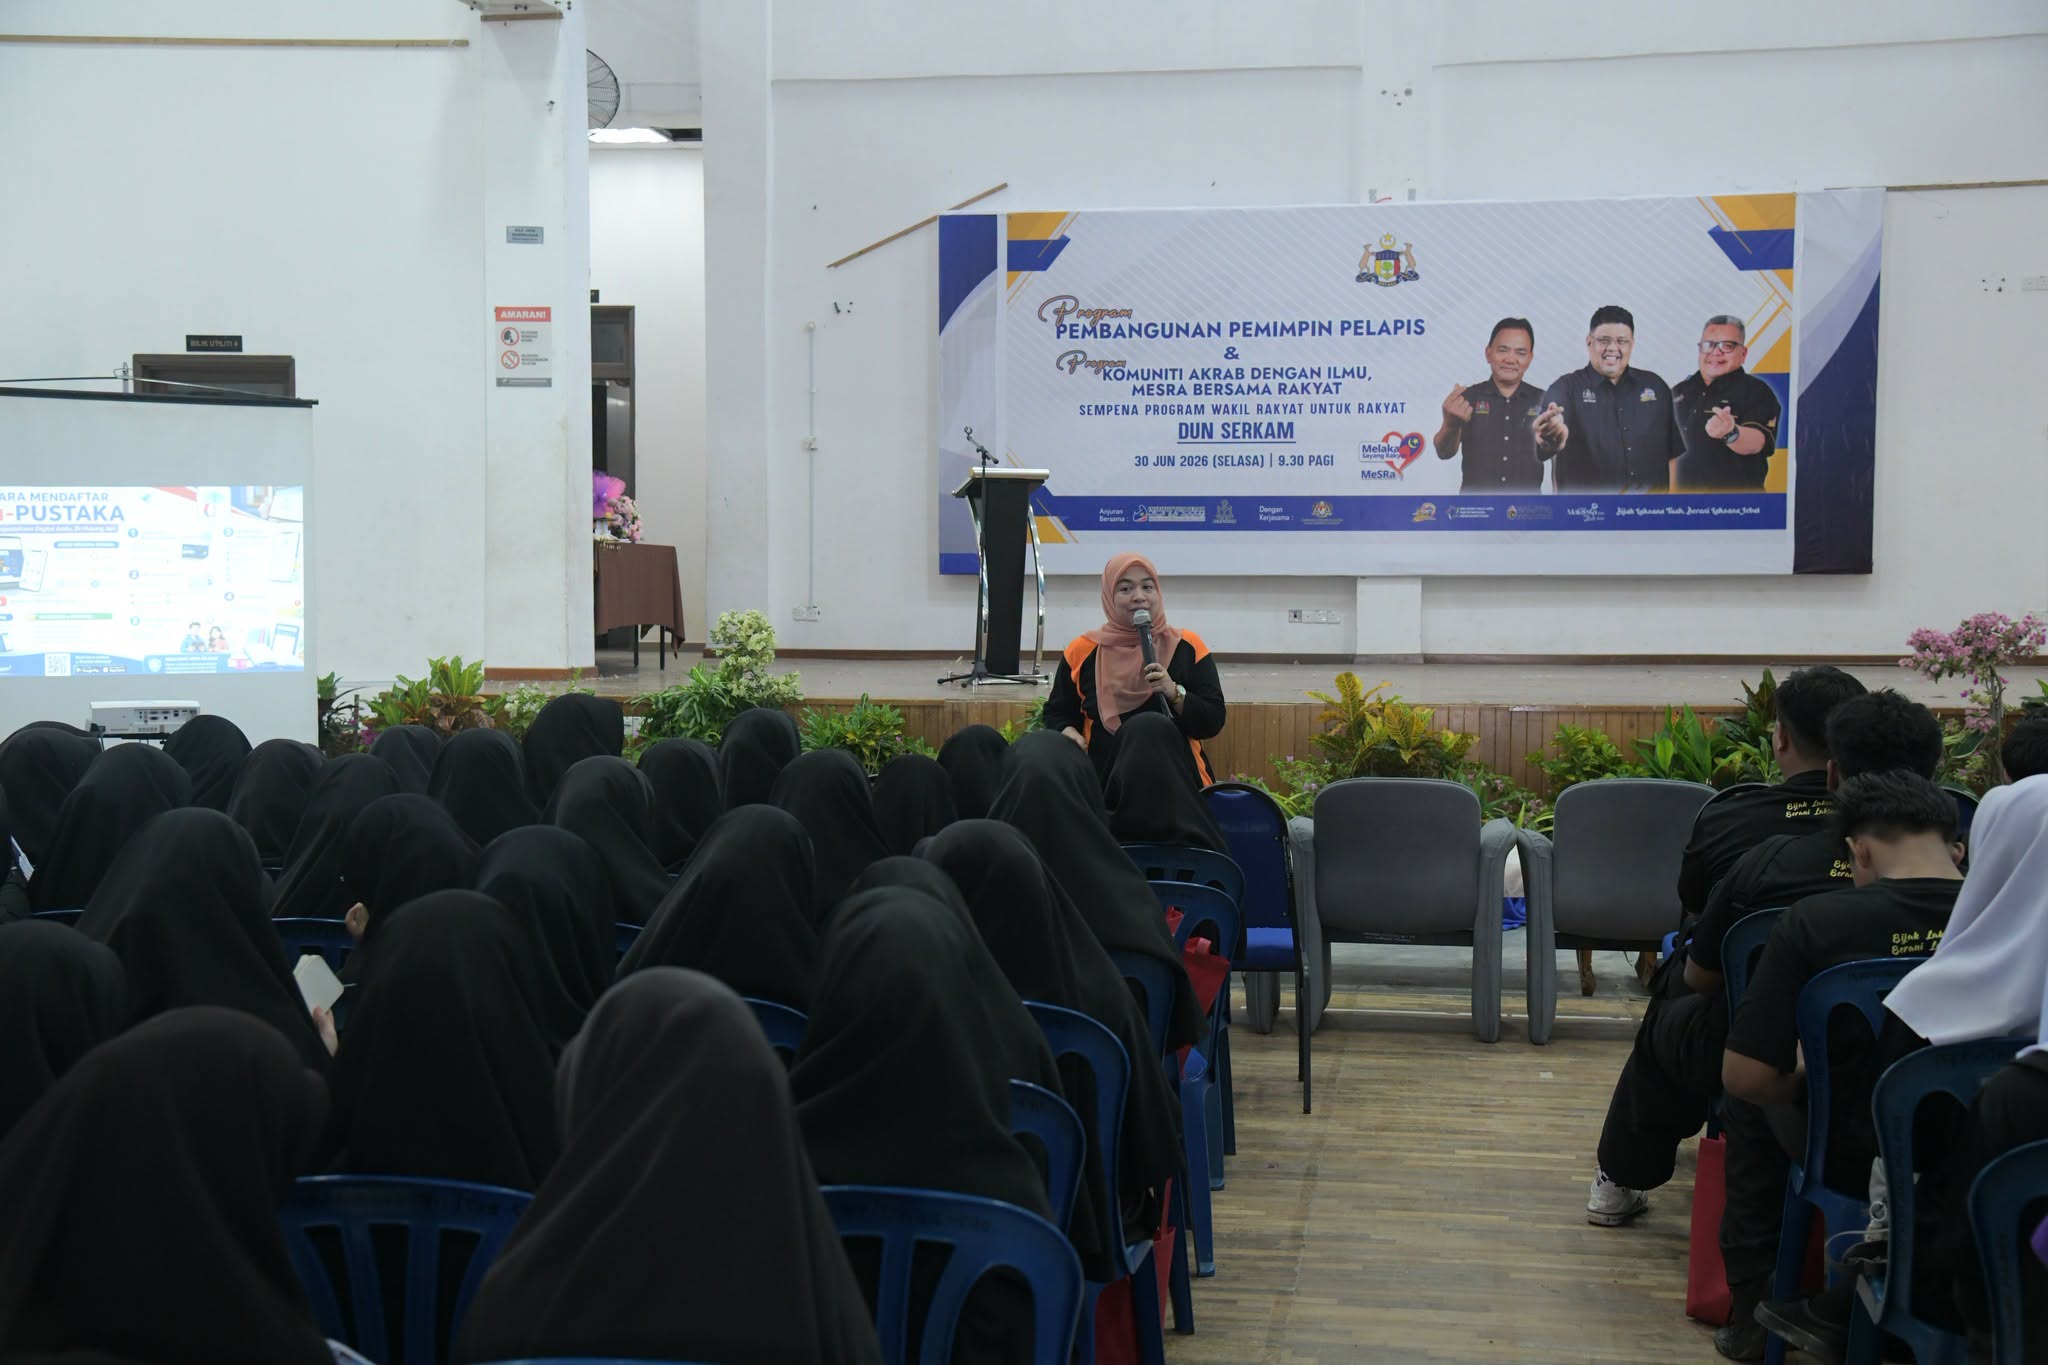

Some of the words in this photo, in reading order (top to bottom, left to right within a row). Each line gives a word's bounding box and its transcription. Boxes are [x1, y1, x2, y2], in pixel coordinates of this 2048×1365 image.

[1038, 294, 1133, 328] Program
[1055, 321, 1222, 340] PEMBANGUNAN
[1229, 320, 1333, 338] PEMIMPIN
[1340, 318, 1426, 336] PELAPIS
[1223, 346, 1240, 360] &
[1055, 349, 1127, 375] Program
[1102, 367, 1183, 382] KOMUNITI
[1188, 367, 1245, 381] AKRAB
[1250, 366, 1322, 380] DENGAN
[1327, 365, 1373, 383] ILMU,
[1131, 383, 1188, 397] MESRA
[1193, 382, 1273, 396] BERSAMA
[1277, 381, 1343, 396] RAKYAT
[1079, 404, 1139, 416] SEMPENA
[1144, 403, 1205, 416] PROGRAM
[1211, 403, 1251, 416] WAKIL
[1256, 402, 1304, 415] RAKYAT
[1310, 402, 1351, 415] UNTUK
[1357, 402, 1406, 414] RAKYAT
[1178, 421, 1214, 440] DUN
[1220, 421, 1294, 440] SERKAM
[1362, 444, 1400, 453] Melaka
[1134, 455, 1149, 467] 30
[1152, 455, 1176, 467] JUN
[1179, 455, 1209, 467] 2026
[1212, 454, 1265, 469] (SELASA)
[1278, 454, 1305, 467] 9.30
[1308, 454, 1335, 467] PAGI
[1361, 470, 1396, 479] MeSRa
[0, 492, 26, 502] ARA
[30, 492, 109, 502] MENDAFTAR
[0, 505, 125, 521] -PUSTAKA
[1259, 505, 1283, 514] Dengan
[1259, 514, 1290, 523] Kerjasama
[1892, 931, 1919, 945] Bijak
[1925, 929, 1944, 940] Lak
[1891, 942, 1924, 956] Berani
